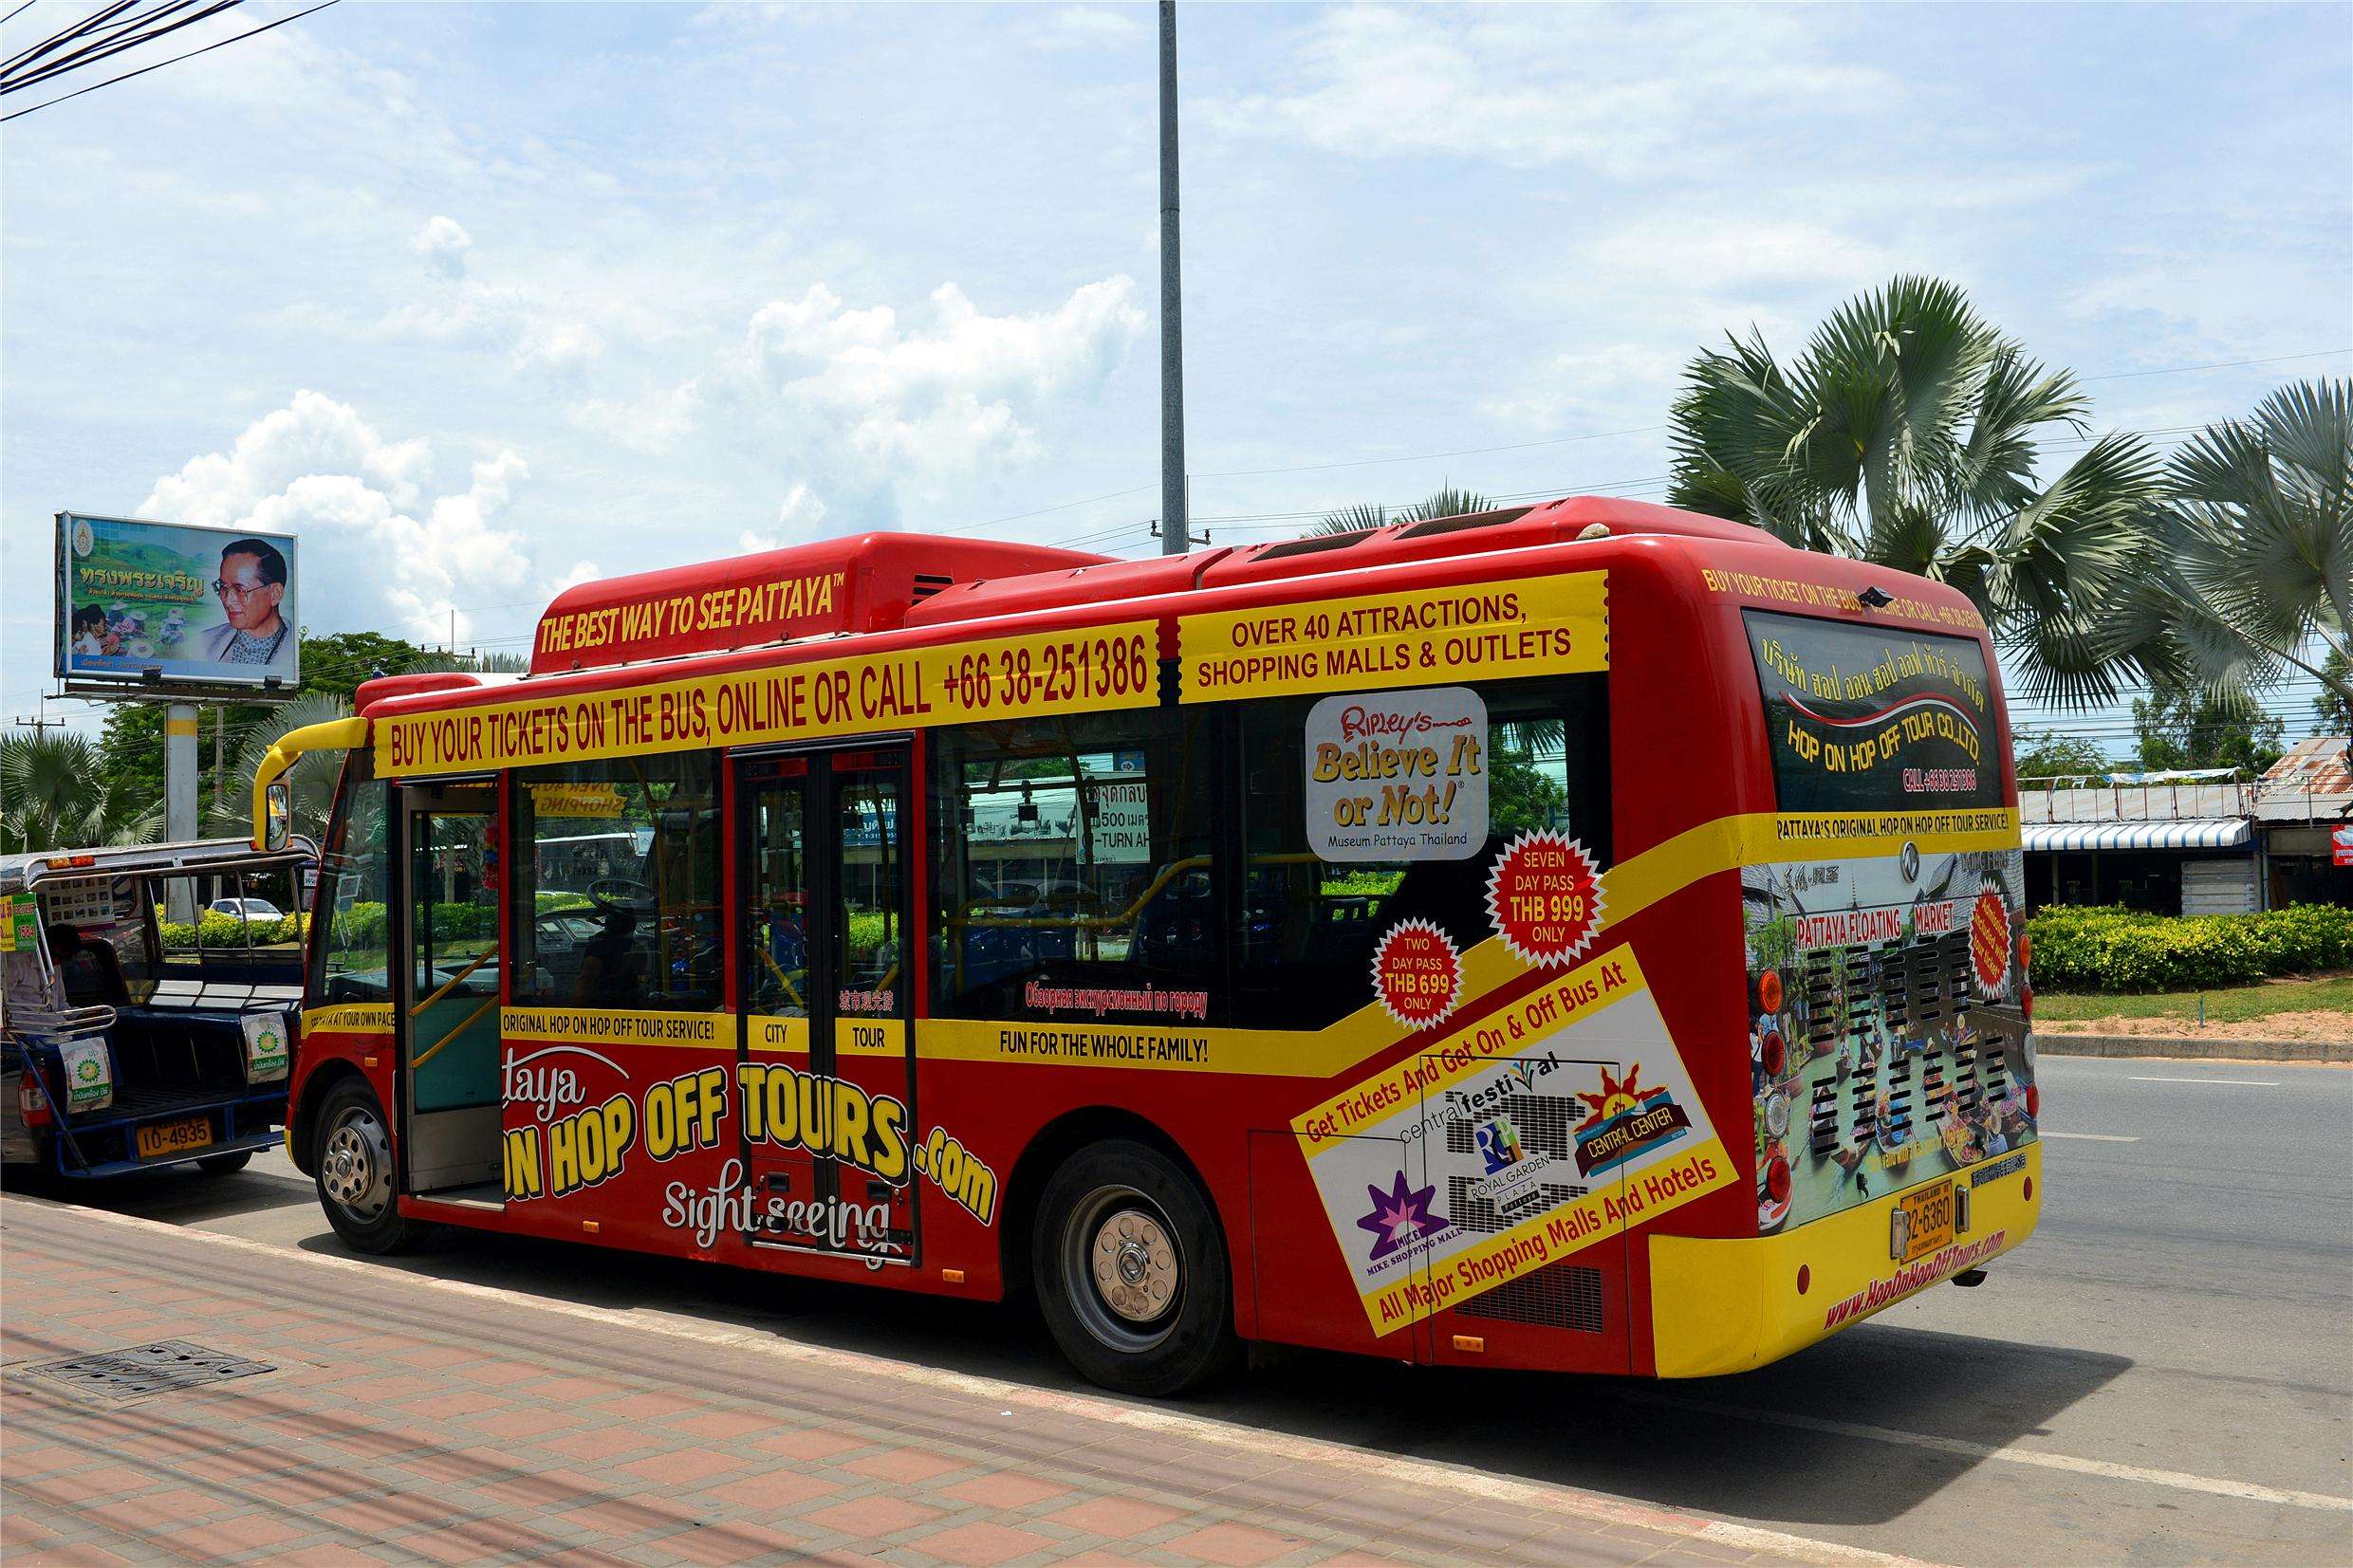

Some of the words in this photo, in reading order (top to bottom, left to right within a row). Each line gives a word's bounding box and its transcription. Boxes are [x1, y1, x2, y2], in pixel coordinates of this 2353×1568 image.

[80, 567, 206, 598] ทรงพระเจริญ
[1701, 569, 1732, 592] BUY
[1730, 572, 1767, 597] YOUR
[1762, 577, 1803, 603] TICKET
[1802, 582, 1820, 605] ON
[1817, 586, 1838, 608] THE
[540, 616, 574, 654] THE
[574, 607, 620, 650] BEST
[621, 599, 666, 641] WAY
[668, 596, 694, 635] TO
[697, 588, 735, 632] SEE
[1232, 617, 1297, 649] OVER
[1304, 613, 1330, 640] 40
[1336, 592, 1528, 637] ATTRACTIONS,
[1197, 652, 1320, 688] SHOPPING
[1326, 642, 1411, 677] MALLS
[1418, 640, 1436, 668] &
[1444, 627, 1573, 666] OUTLETS
[1762, 638, 1807, 692] บริษัท
[1844, 673, 1875, 700] ออน
[390, 723, 426, 767] BUY
[430, 715, 483, 763] YOUR
[487, 704, 569, 758] TICKETS
[575, 703, 606, 751] ON
[610, 695, 654, 747] THE
[659, 687, 713, 747] BUS,
[718, 676, 807, 736] ONLINE
[814, 670, 852, 724] OR
[860, 661, 932, 720] CALL
[943, 653, 991, 710] +66
[1000, 634, 1148, 704] 38-251386
[1788, 719, 1820, 763] HOP
[1825, 743, 1846, 772] ON
[1849, 739, 1877, 772] HOP
[1879, 725, 1901, 760] OFF
[1901, 711, 1936, 744] TOUR
[1312, 740, 1438, 783] Believe
[1448, 734, 1482, 776] It
[1902, 767, 1923, 793] CALL
[1102, 812, 1125, 828] 500
[1333, 796, 1375, 828] or
[1777, 820, 1830, 839] PATTAYA'S
[1832, 818, 1878, 839] ORIGINAL
[1880, 816, 1899, 836] HOP
[1899, 816, 1914, 835] ON
[1915, 816, 1933, 835] HOP
[1935, 815, 1951, 835] OFF
[1952, 814, 1973, 832] TOUR
[1974, 813, 2010, 831] SERVICE!
[1328, 834, 1371, 848] Museum
[1374, 832, 1417, 849] Pattaya
[1418, 831, 1467, 847] Thailand
[1524, 852, 1565, 868] SEVEN
[1515, 875, 1539, 891] DAY
[1544, 875, 1575, 891] PASS
[1510, 896, 1545, 922] THB
[1550, 895, 1584, 922] 999
[1532, 926, 1566, 943] ONLY
[1796, 914, 1848, 950] PATTAYA
[1848, 907, 1902, 943] FLOATING
[1914, 901, 1955, 936] MARKET
[1404, 938, 1430, 950] TWO
[1392, 957, 1414, 969] DAY
[1417, 958, 1442, 970] PASS
[1385, 972, 1417, 993] THB
[1419, 973, 1450, 994] 699
[1026, 981, 1073, 1015] Обзорная
[1155, 990, 1169, 1012] по
[1169, 990, 1209, 1020] городу
[1404, 997, 1432, 1010] ONLY
[343, 1011, 361, 1026] YOUR
[361, 1011, 377, 1026] OWN
[503, 1015, 547, 1035] ORIGINAL
[549, 1015, 570, 1035] HOP
[572, 1016, 587, 1035] ON
[589, 1016, 611, 1036] HOP
[613, 1016, 633, 1036] OFF
[635, 1018, 663, 1038] TOUR
[666, 1020, 714, 1040] SERVICE!
[765, 1024, 787, 1043] CITY
[852, 1027, 885, 1048] TOUR
[999, 1029, 1028, 1055] FUN
[1030, 1031, 1059, 1055] FOR
[1061, 1033, 1088, 1057] THE
[1091, 1034, 1145, 1060] WHOLE
[1148, 1036, 1209, 1063] FAMILY!
[1305, 1117, 1333, 1144] Get
[1335, 1081, 1401, 1133] Tickets
[1403, 1057, 1442, 1098] And
[1440, 1042, 1476, 1074] Get
[1476, 1027, 1507, 1061] On
[1508, 1013, 1526, 1040] &
[1524, 994, 1558, 1031] Off
[1561, 976, 1600, 1014] Bus
[1601, 960, 1627, 993] At
[548, 1093, 637, 1197] HOP
[643, 1065, 728, 1163] OFF
[1587, 1128, 1634, 1158] CENTRAL
[1631, 1107, 1674, 1137] CENTER
[1471, 1177, 1506, 1199] ROYAL
[1506, 1155, 1550, 1182] GARDEN
[1496, 1181, 1537, 1204] PLAZA
[1913, 1186, 1941, 1206] THAILAND
[1366, 1261, 1390, 1276] MIKE
[1390, 1239, 1436, 1264] SHOPPING
[1436, 1227, 1463, 1245] MALL
[1378, 1296, 1403, 1323] All
[1408, 1268, 1457, 1314] Major
[1462, 1226, 1548, 1288] Shopping
[1547, 1204, 1602, 1245] Malls
[1605, 1182, 1644, 1221] And
[1647, 1156, 1717, 1205] Hotels
[1396, 1229, 1421, 1248] MIKE
